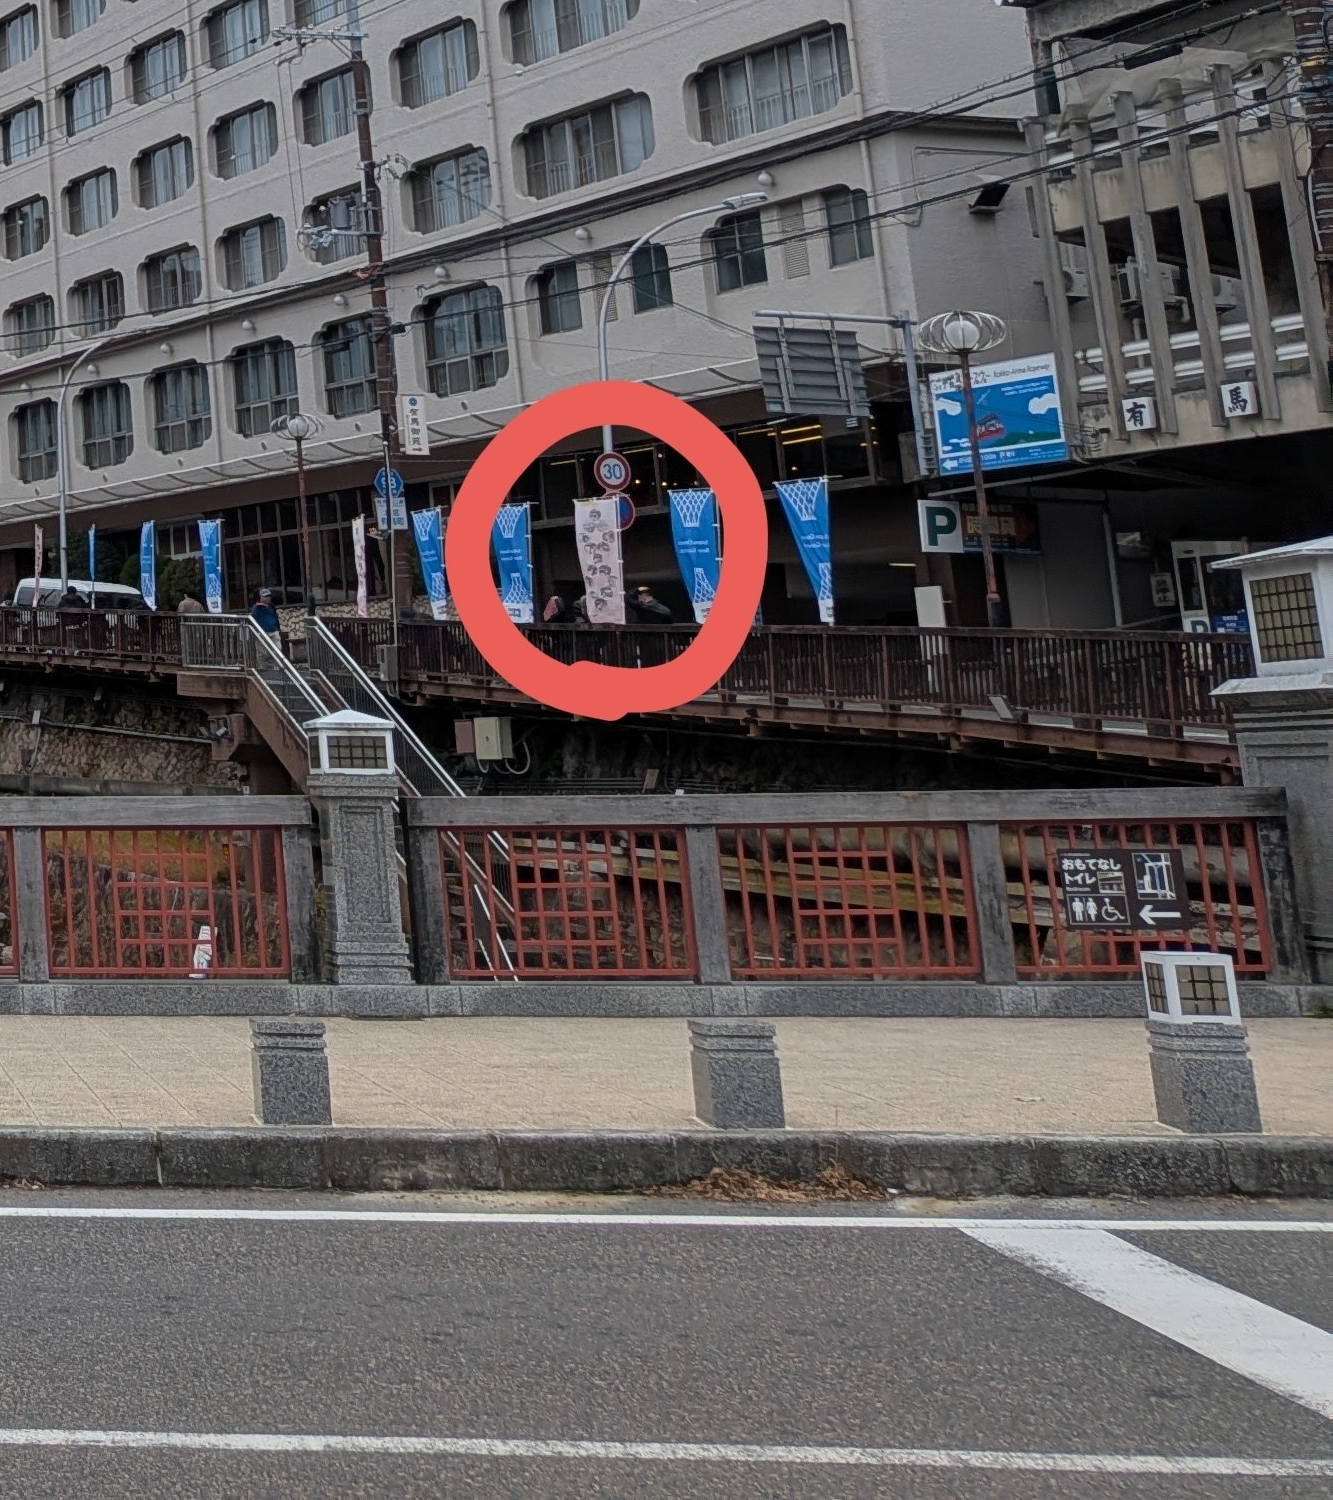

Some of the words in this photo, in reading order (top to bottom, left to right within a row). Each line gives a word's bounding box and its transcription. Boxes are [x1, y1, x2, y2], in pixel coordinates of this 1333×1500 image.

[1125, 401, 1147, 428] 有
[1227, 385, 1249, 413] 馬
[602, 463, 623, 480] 30
[925, 506, 958, 547] P
[1061, 857, 1122, 871] おもてなし
[1063, 872, 1097, 885] トイレ
